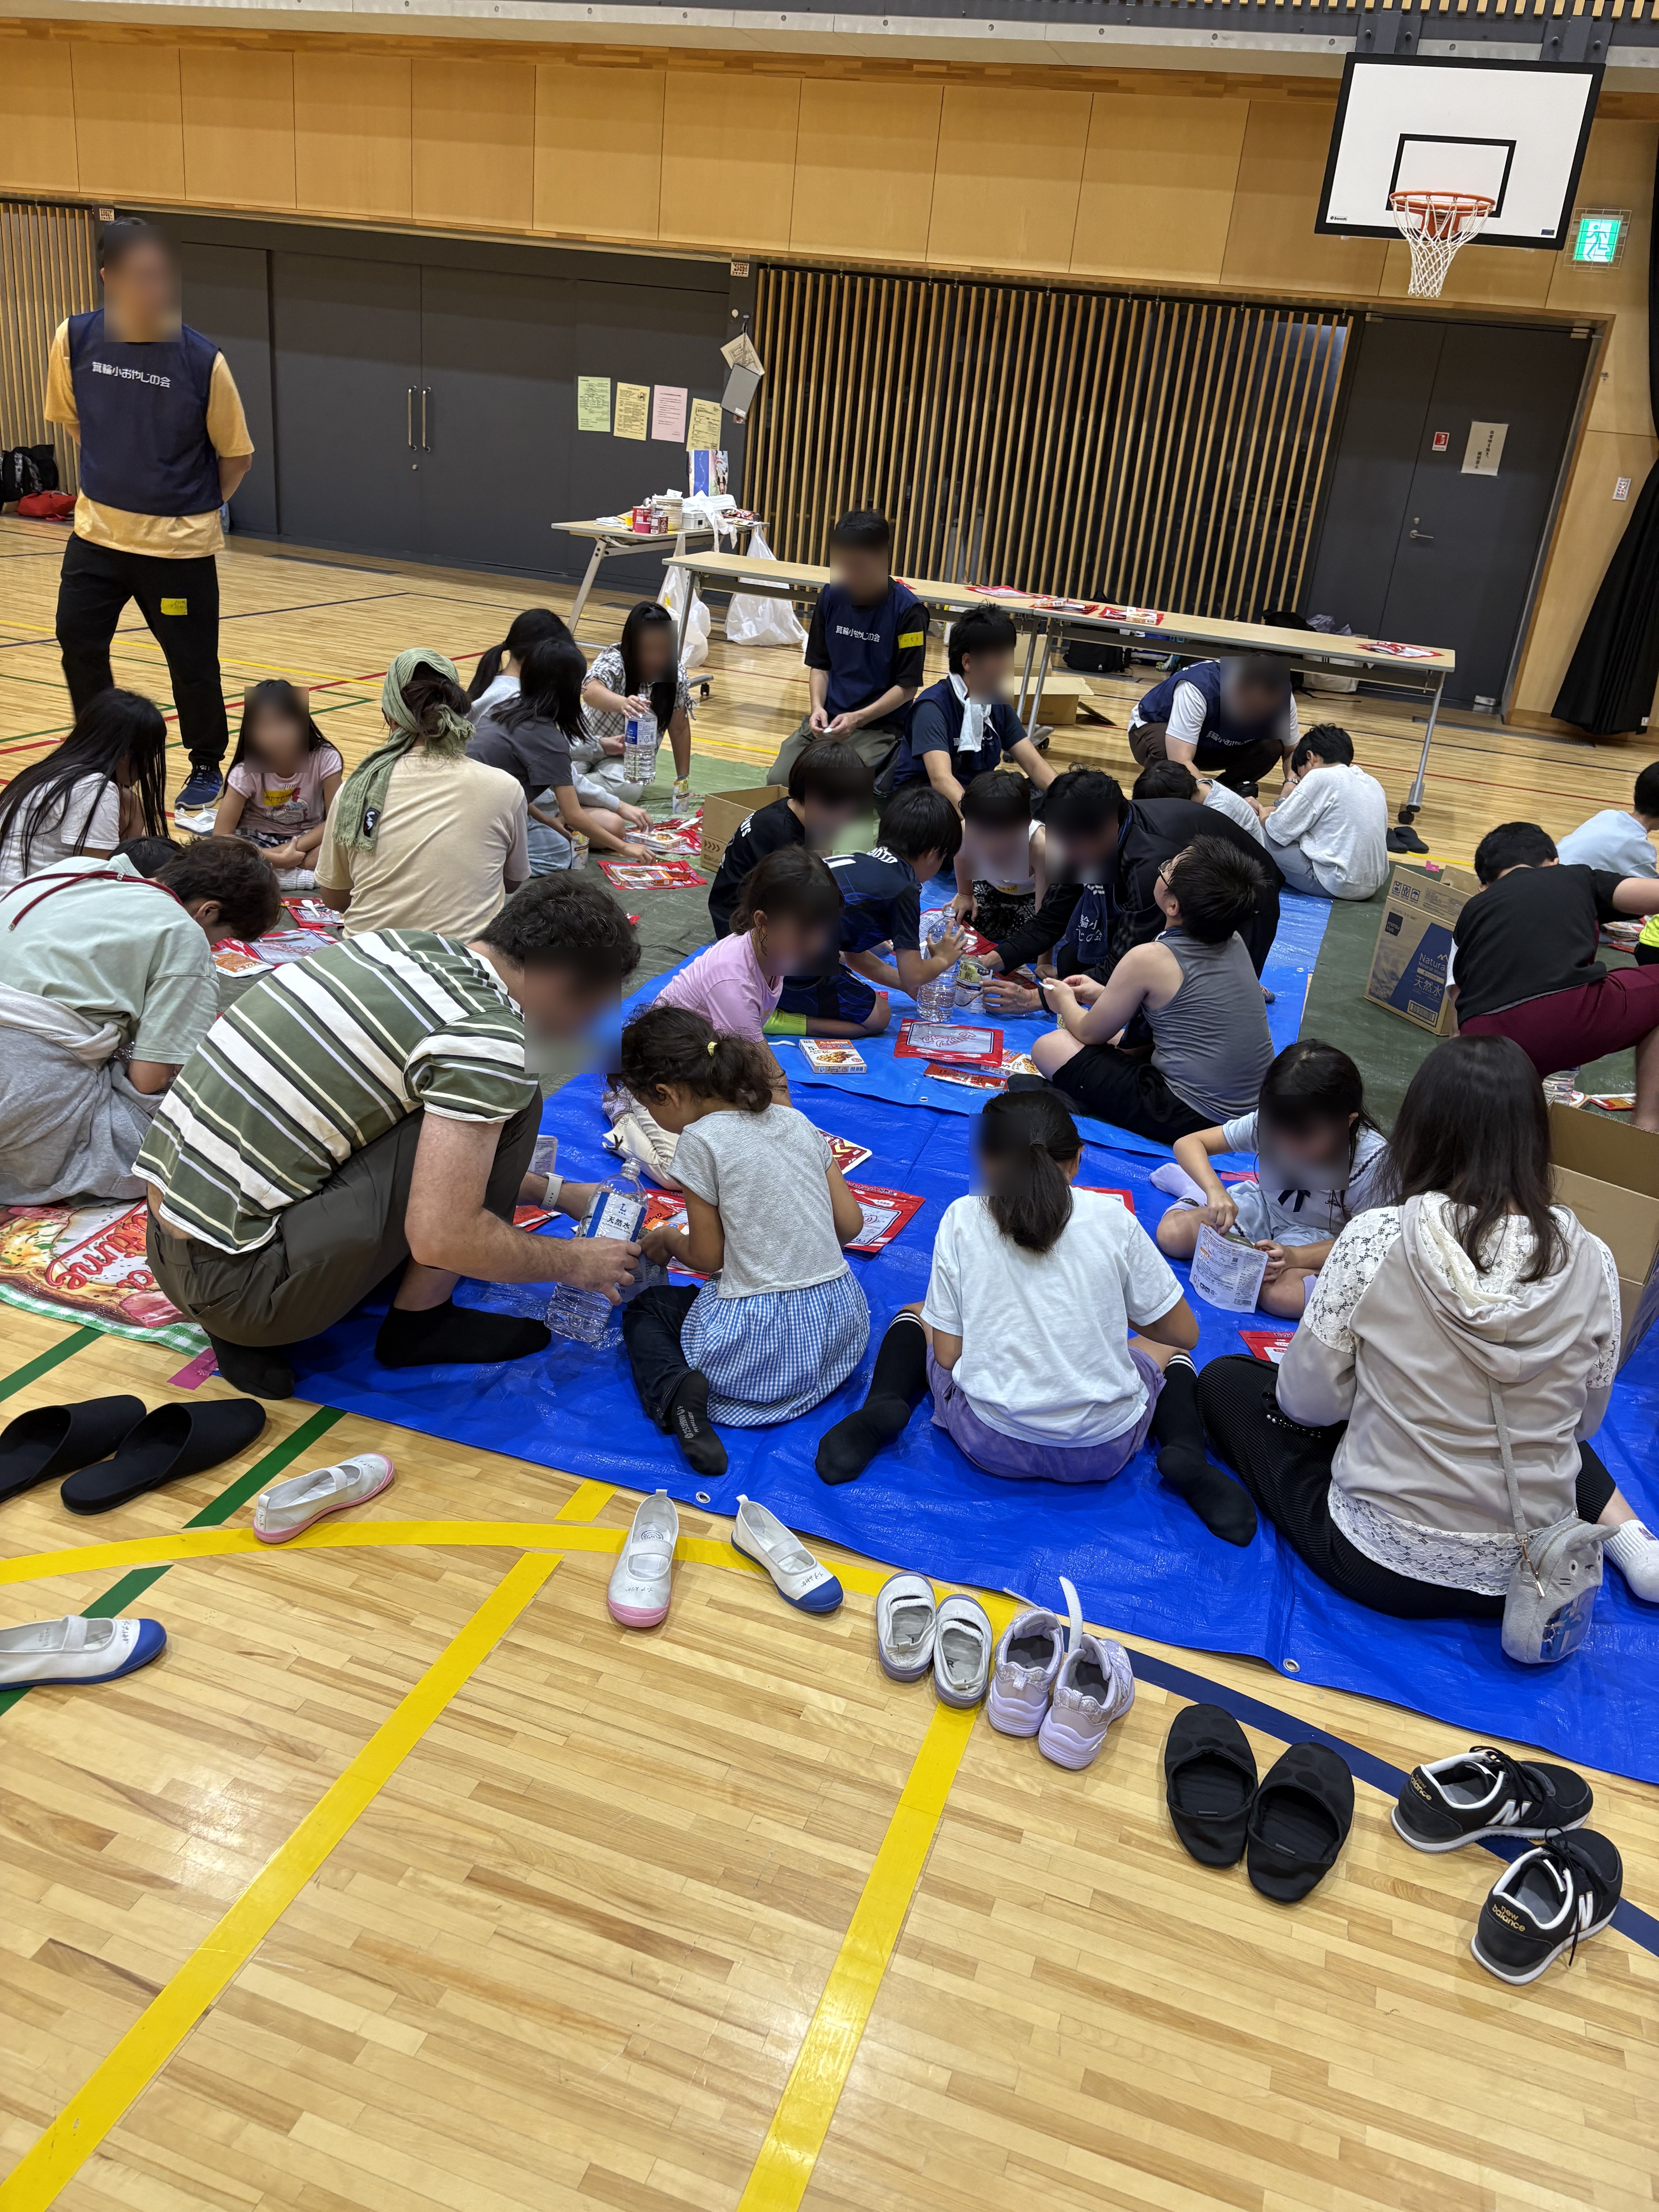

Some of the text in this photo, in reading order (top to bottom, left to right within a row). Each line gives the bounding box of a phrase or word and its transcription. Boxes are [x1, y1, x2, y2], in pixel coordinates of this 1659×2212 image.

[92, 362, 171, 388] 箕輪小おやじの会
[1419, 953, 1447, 972] Natura
[1413, 974, 1443, 997] 天然水
[607, 1216, 630, 1229] 天然水
[1492, 1904, 1525, 1932] new balance
